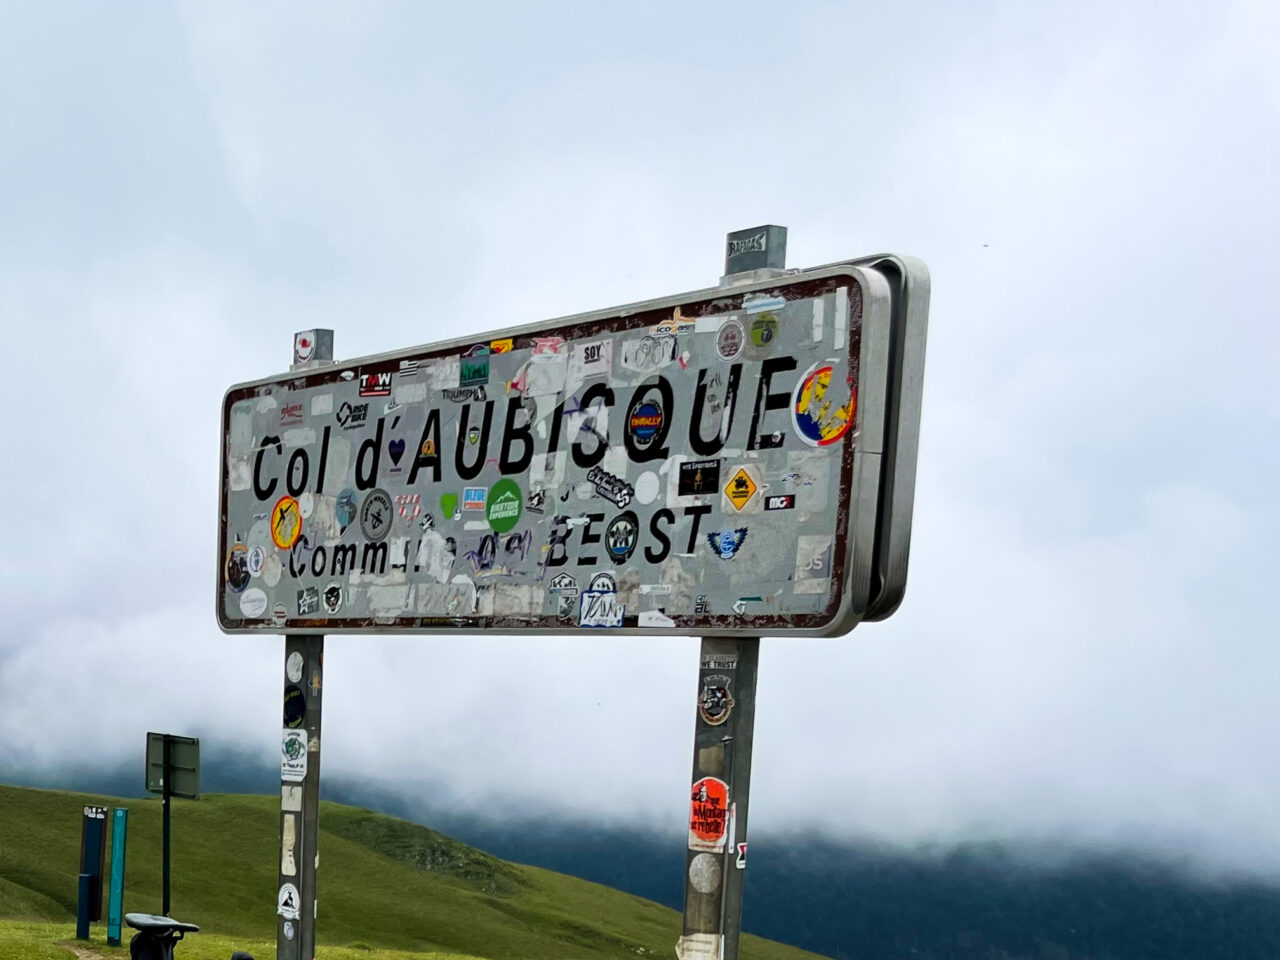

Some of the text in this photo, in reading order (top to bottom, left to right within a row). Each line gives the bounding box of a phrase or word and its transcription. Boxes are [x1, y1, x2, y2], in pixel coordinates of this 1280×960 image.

[360, 372, 391, 387] TMW
[253, 425, 332, 501] Col
[355, 356, 798, 491] d'AUBISQUE
[548, 504, 713, 567] BEOST
